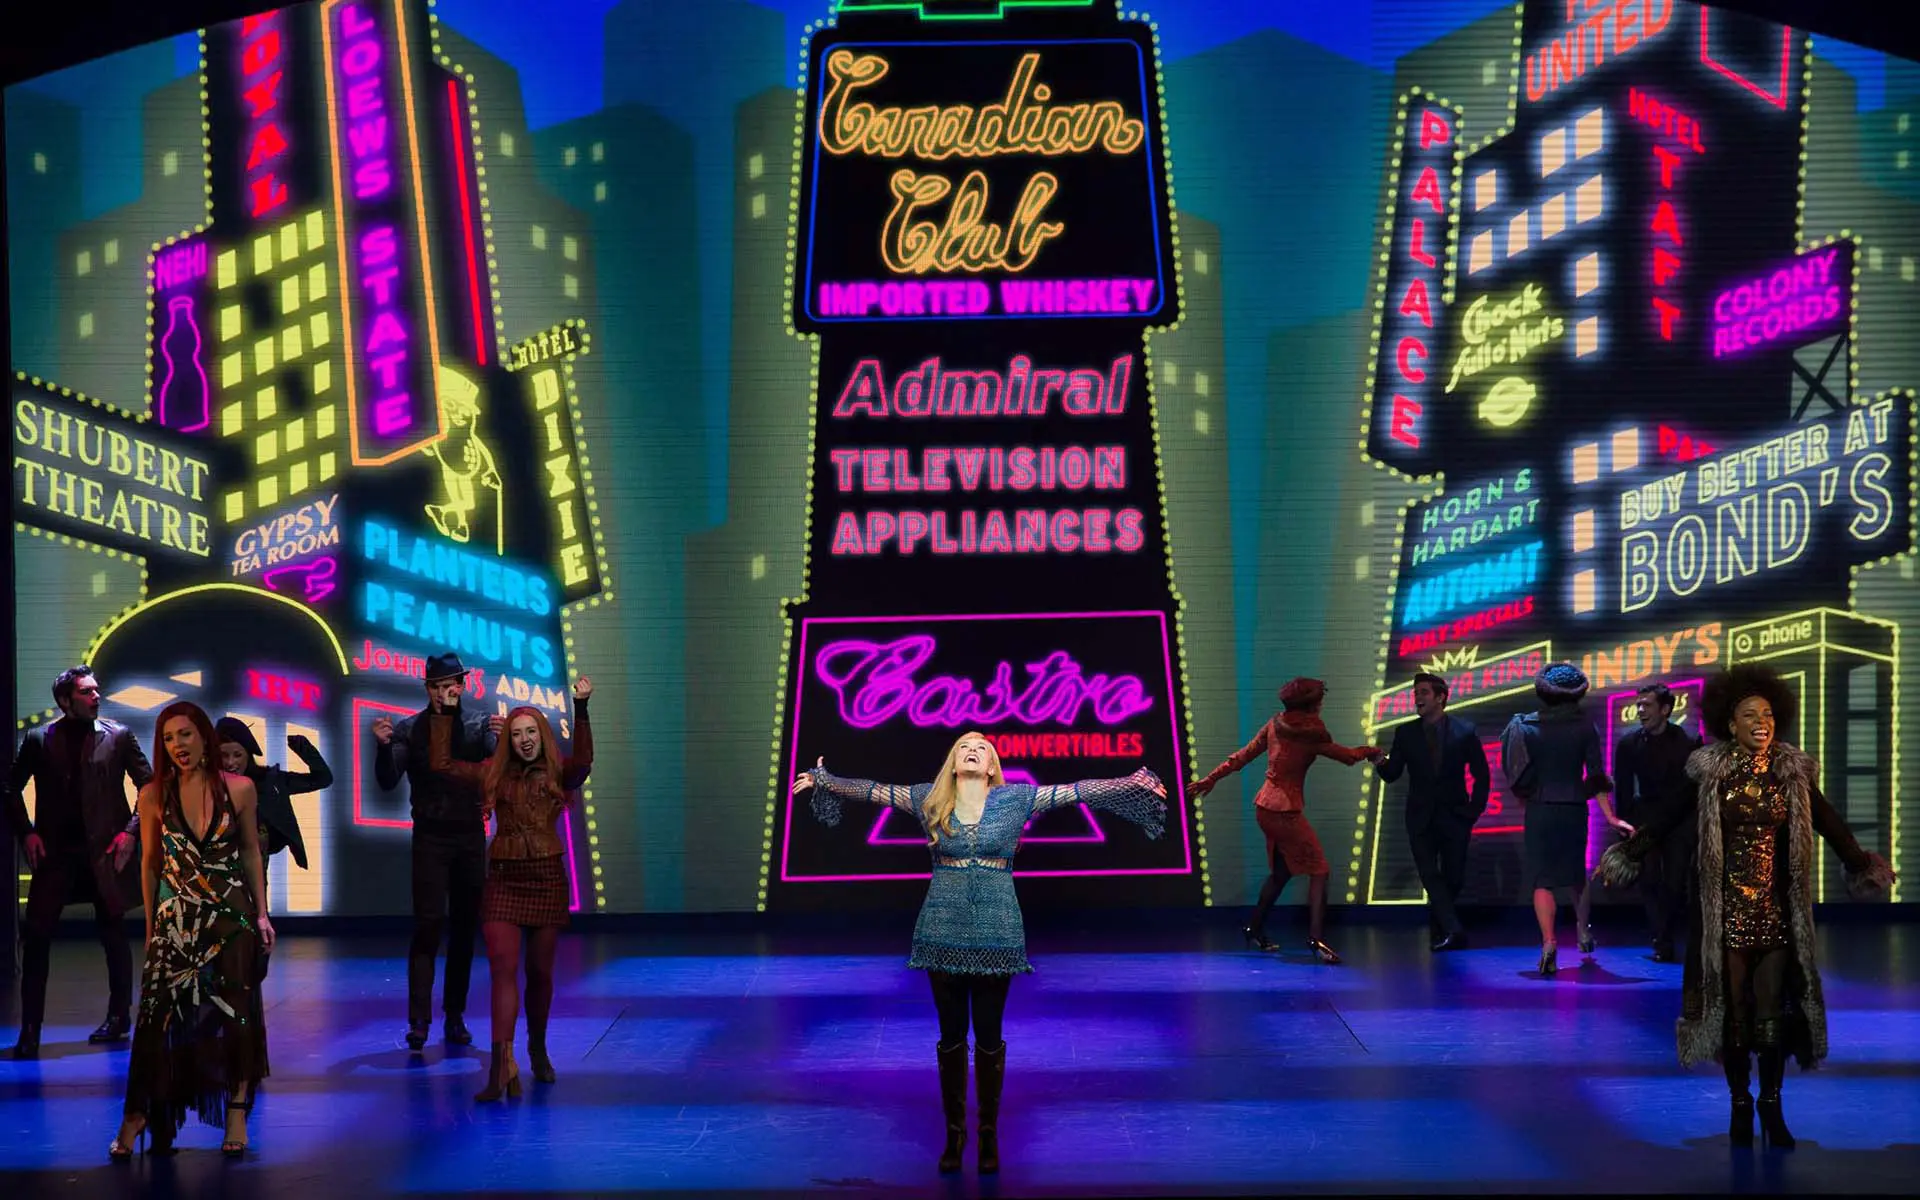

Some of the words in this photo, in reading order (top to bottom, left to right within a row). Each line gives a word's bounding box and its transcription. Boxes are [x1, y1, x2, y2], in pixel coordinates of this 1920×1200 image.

[1526, 0, 1674, 102] UNITED
[342, 5, 391, 198] LOEWS
[819, 51, 1145, 159] Canadian
[1629, 86, 1706, 154] HOTEL
[881, 169, 1064, 273] Club
[1652, 145, 1683, 341] TAFT
[157, 242, 206, 291] NEHI
[819, 282, 990, 315] IMPORTED
[1000, 279, 1155, 313] WHISKEY
[1390, 109, 1450, 449] PALACE
[1715, 249, 1838, 322] COLONY
[361, 227, 413, 435] STATE
[518, 328, 575, 369] HOTEL
[1462, 283, 1543, 344] Chock
[1714, 285, 1840, 357] RECORDS
[832, 355, 1132, 417] Admiral
[15, 399, 210, 501] SHUBERT
[532, 368, 588, 586] DIXIE
[831, 446, 1126, 492] TELEVISION
[1621, 461, 1687, 530] BUY
[1697, 423, 1830, 504] BETTER
[1844, 398, 1894, 455] AT
[14, 456, 211, 557] THEATRE
[234, 493, 340, 557] GYPSY
[832, 508, 1145, 554] APPLIANCES
[1411, 498, 1541, 567] HARDART
[1422, 478, 1503, 533] HORN
[1620, 452, 1894, 614] BOND'S
[231, 553, 262, 577] TEA
[266, 525, 340, 565] ROOM
[364, 520, 551, 617] PLANTERS
[1403, 540, 1544, 626] AUTOMAT
[366, 581, 555, 678] PEANUTS
[1399, 624, 1450, 657] DAILY
[1451, 595, 1535, 640] SPECIALS
[1565, 622, 1722, 692] INDY'S
[1759, 619, 1813, 651] phone
[247, 668, 321, 710] IRT
[496, 673, 567, 714] ADAM
[815, 635, 1154, 728] Castro
[1482, 650, 1543, 690] KING
